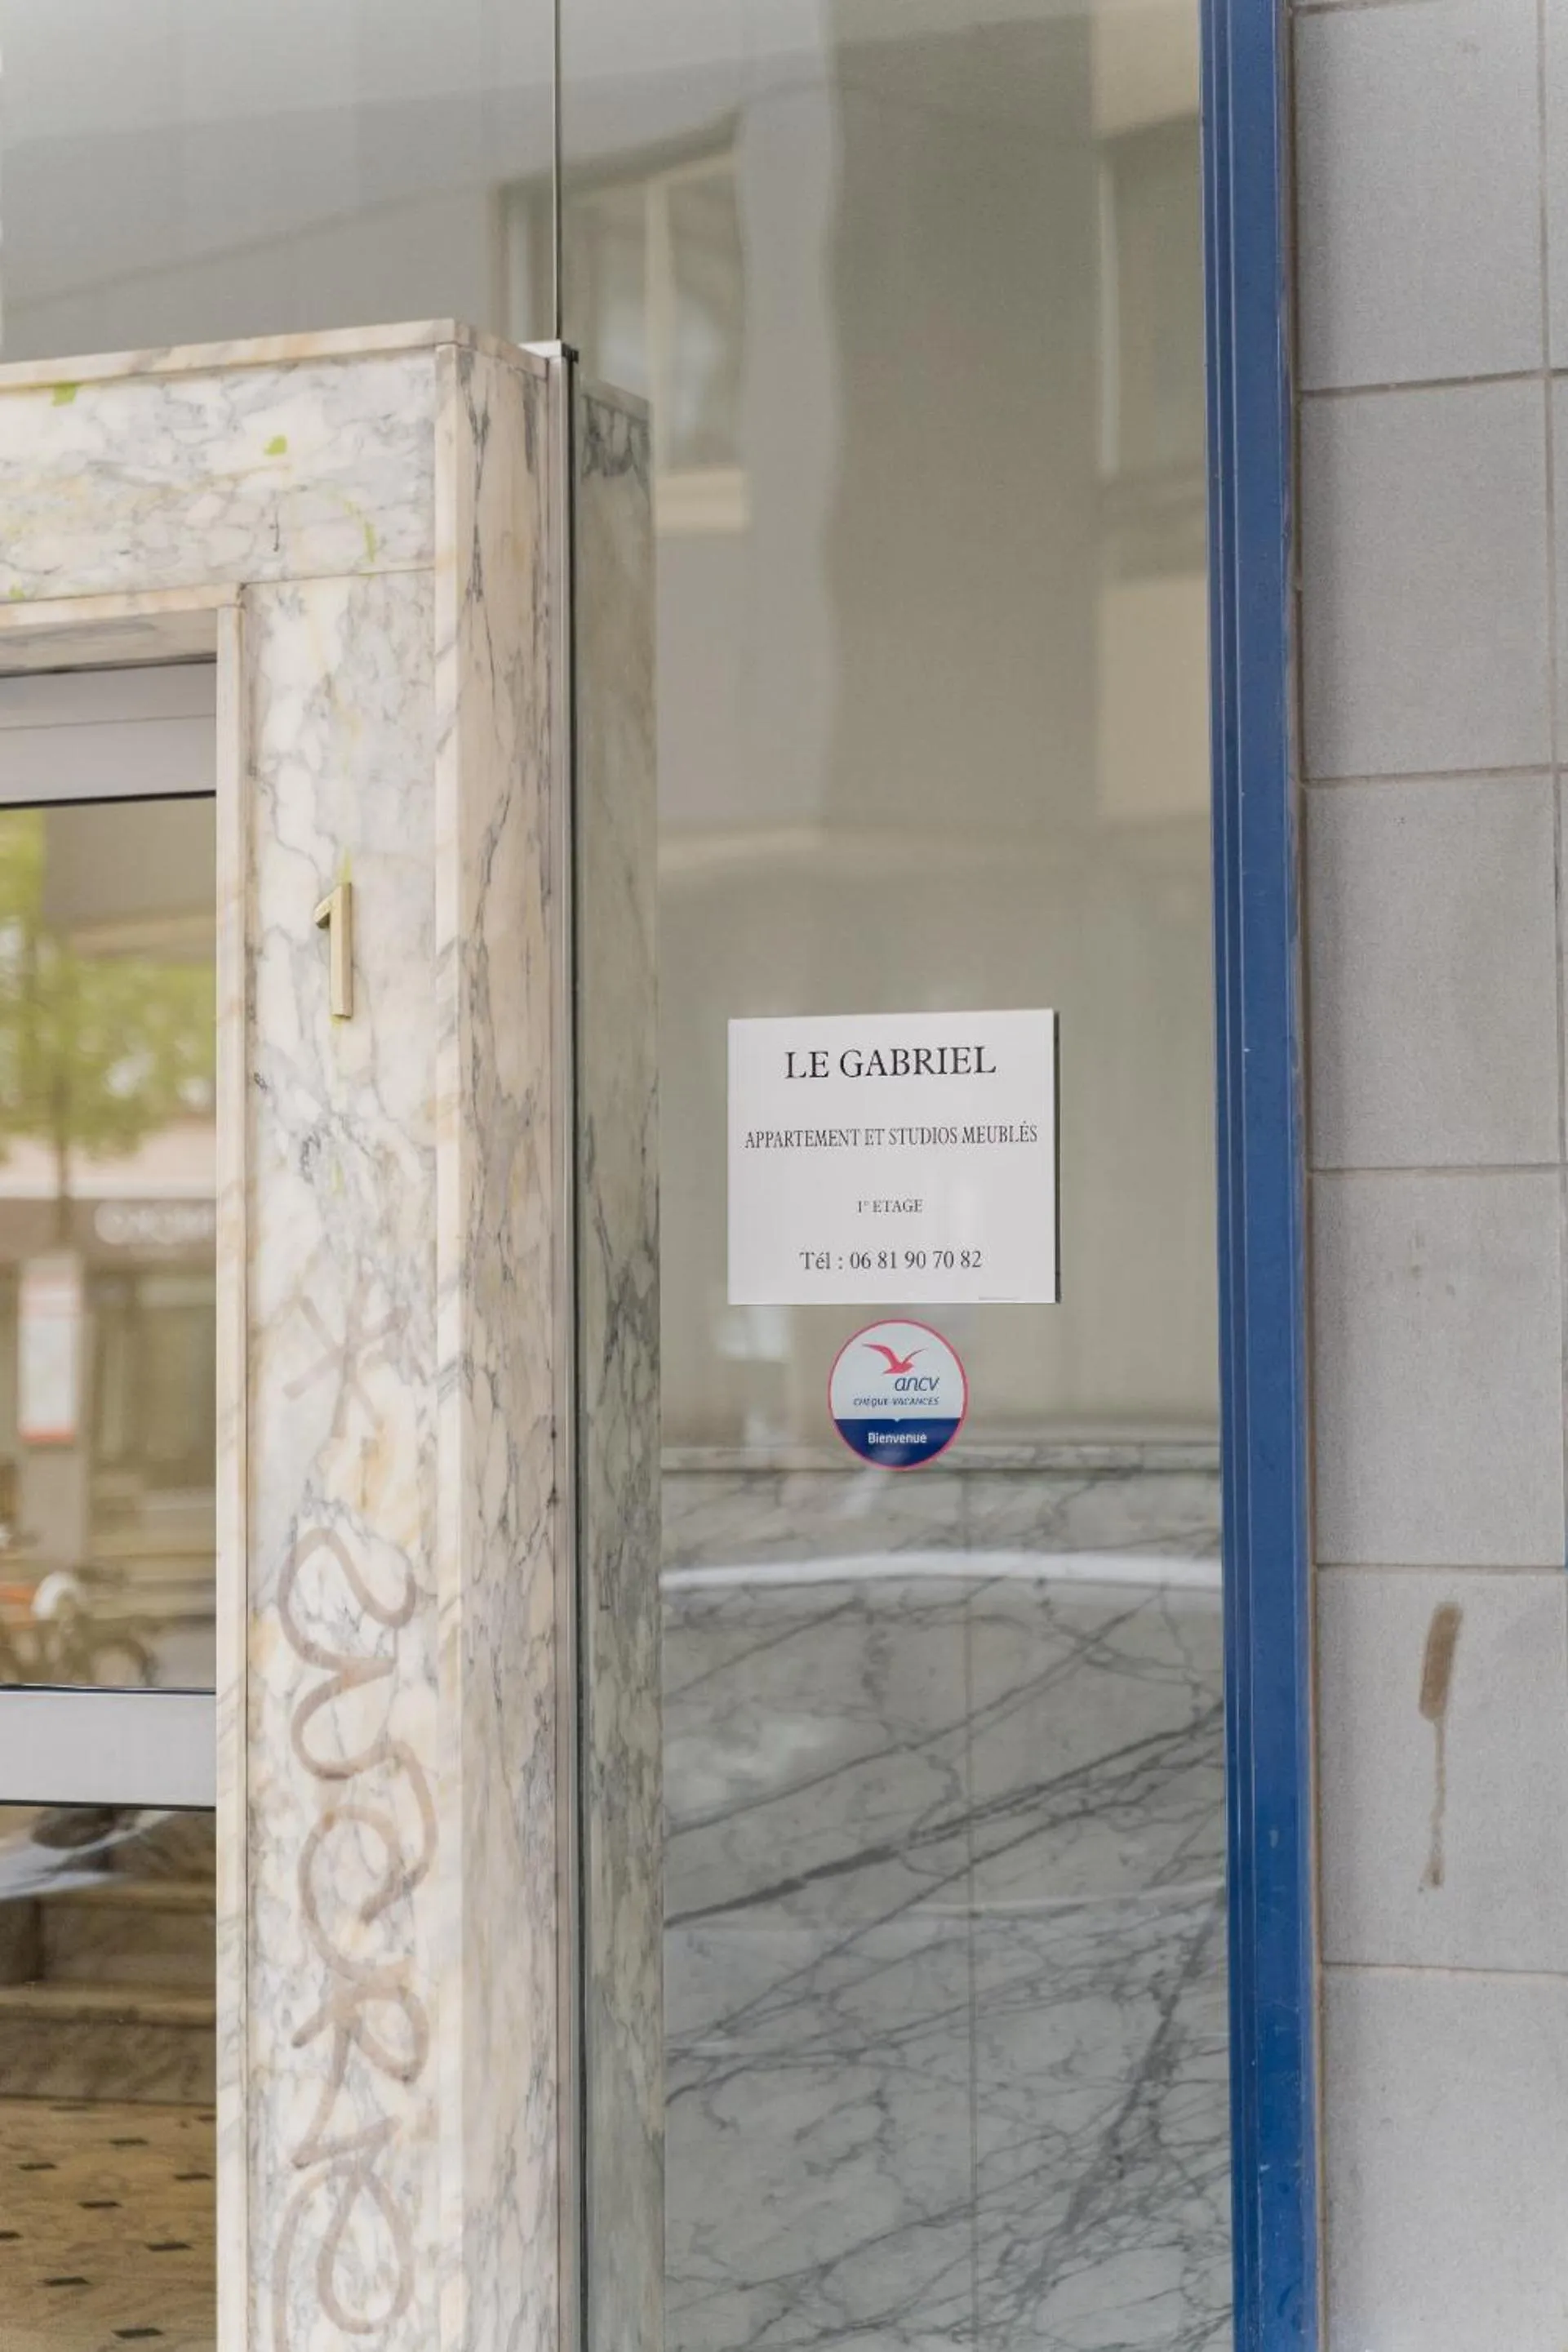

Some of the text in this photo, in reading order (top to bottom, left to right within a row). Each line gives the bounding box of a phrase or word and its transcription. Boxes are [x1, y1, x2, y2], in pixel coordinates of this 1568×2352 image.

[313, 882, 353, 1018] 1
[784, 1046, 997, 1078] LE GABRIEL
[744, 1120, 1038, 1149] APPARTEMENT ET STUDIOS MEUBLÉS
[873, 1199, 923, 1213] ETAGE
[799, 1251, 831, 1270] Tél
[850, 1252, 871, 1269] 06
[877, 1251, 897, 1269] 81
[904, 1251, 926, 1269] 90
[932, 1250, 954, 1268] 70
[960, 1250, 982, 1268] 82
[895, 1376, 939, 1391] ancv
[868, 1432, 927, 1444] Bienvenue
